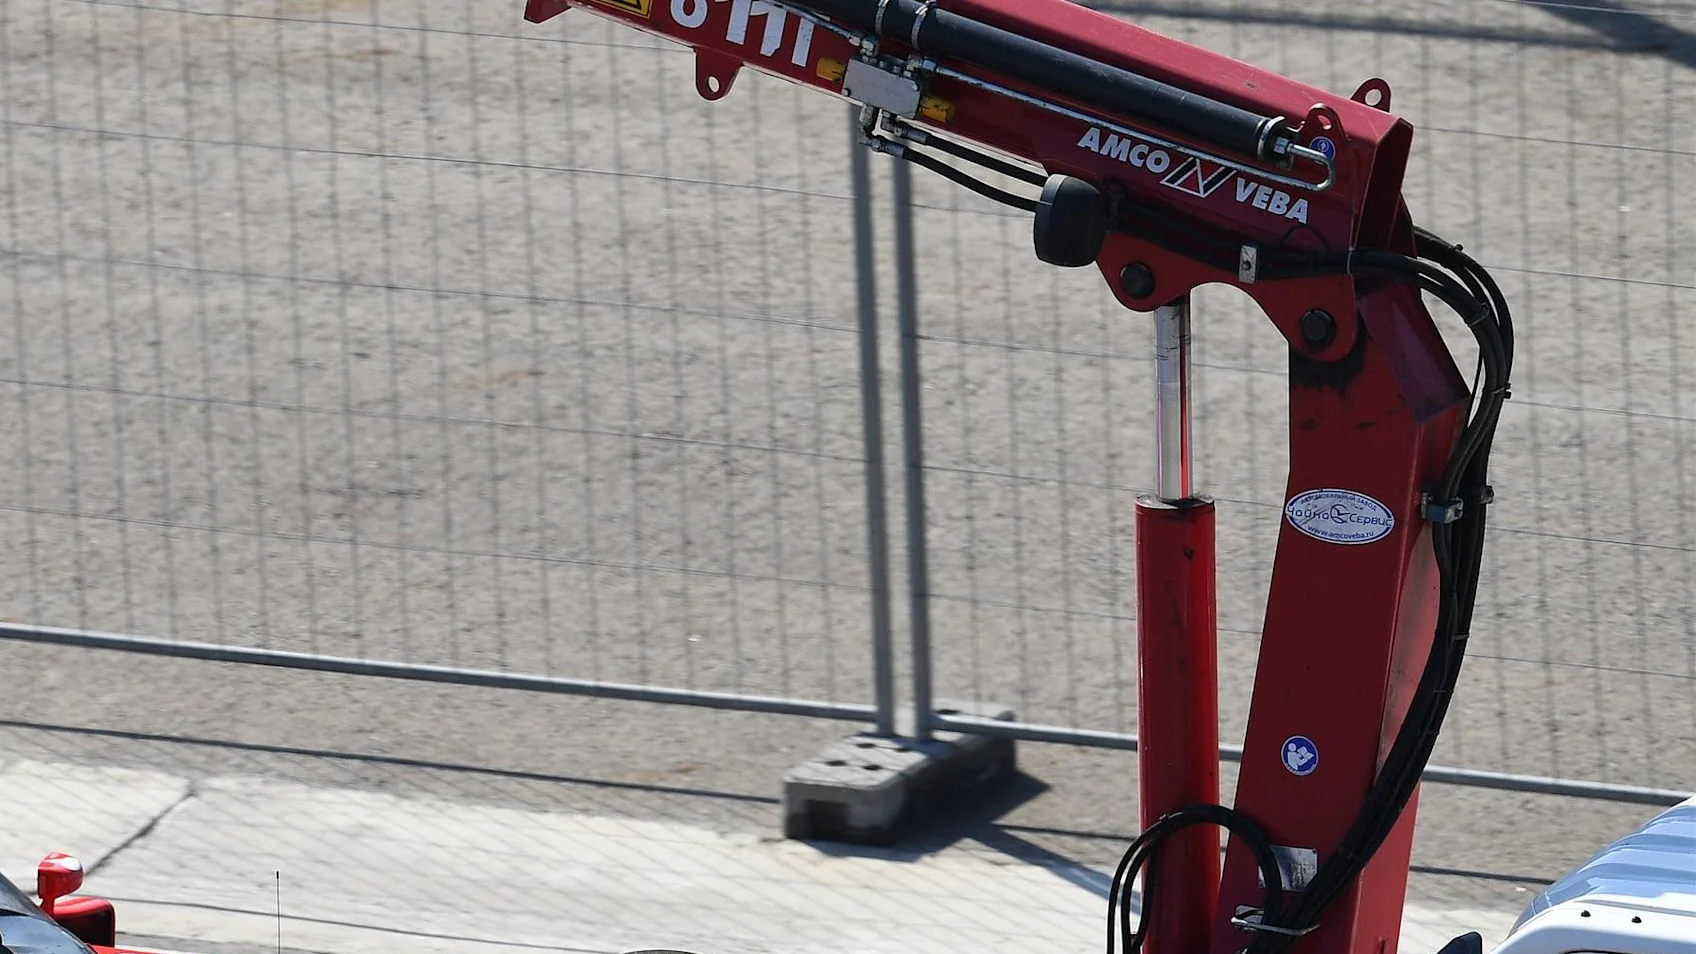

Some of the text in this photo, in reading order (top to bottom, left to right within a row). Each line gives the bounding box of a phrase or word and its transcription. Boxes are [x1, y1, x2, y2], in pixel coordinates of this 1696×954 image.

[1077, 126, 1309, 225] AMCO VEBA
[1307, 524, 1375, 540] www.amcoveba.ru
